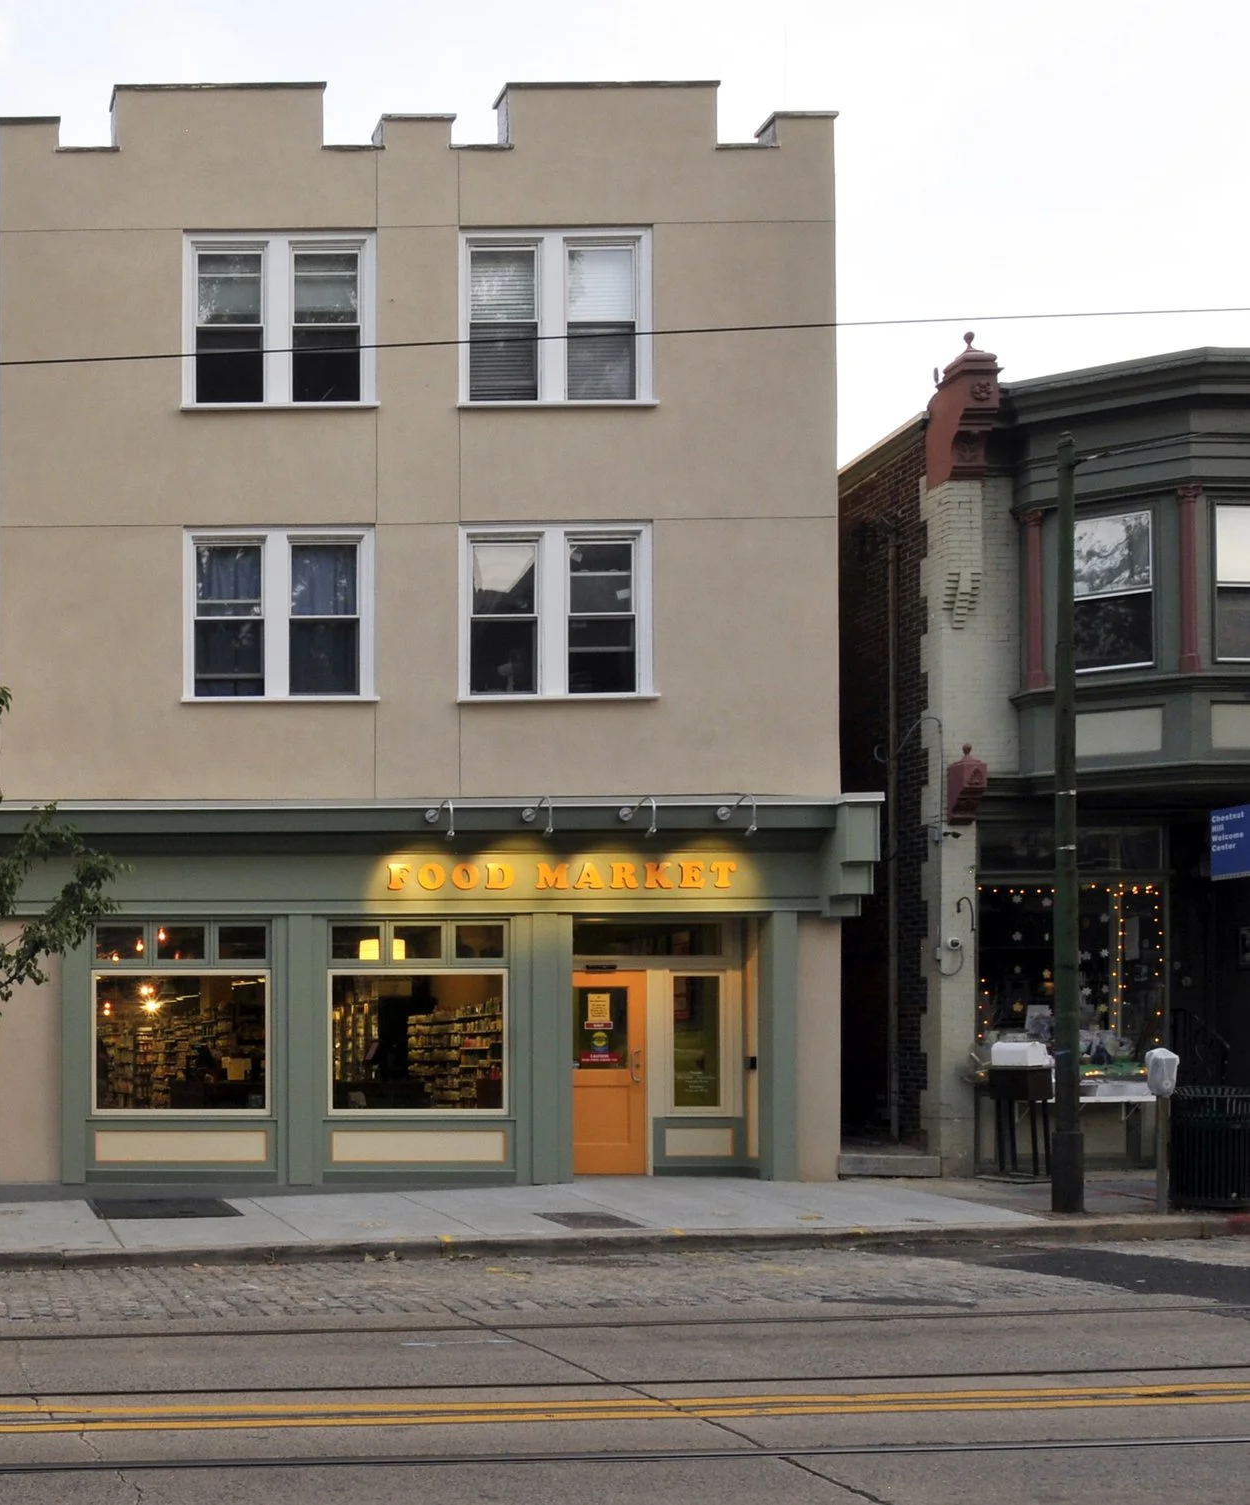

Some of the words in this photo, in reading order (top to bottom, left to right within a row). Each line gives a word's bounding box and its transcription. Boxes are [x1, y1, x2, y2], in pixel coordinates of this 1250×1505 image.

[1212, 811, 1244, 822] Chestnut
[1211, 824, 1224, 832] Hill
[1211, 832, 1244, 842] Welcome
[1211, 843, 1237, 852] Center
[386, 862, 516, 890] FOOD
[535, 861, 736, 889] MARKET
